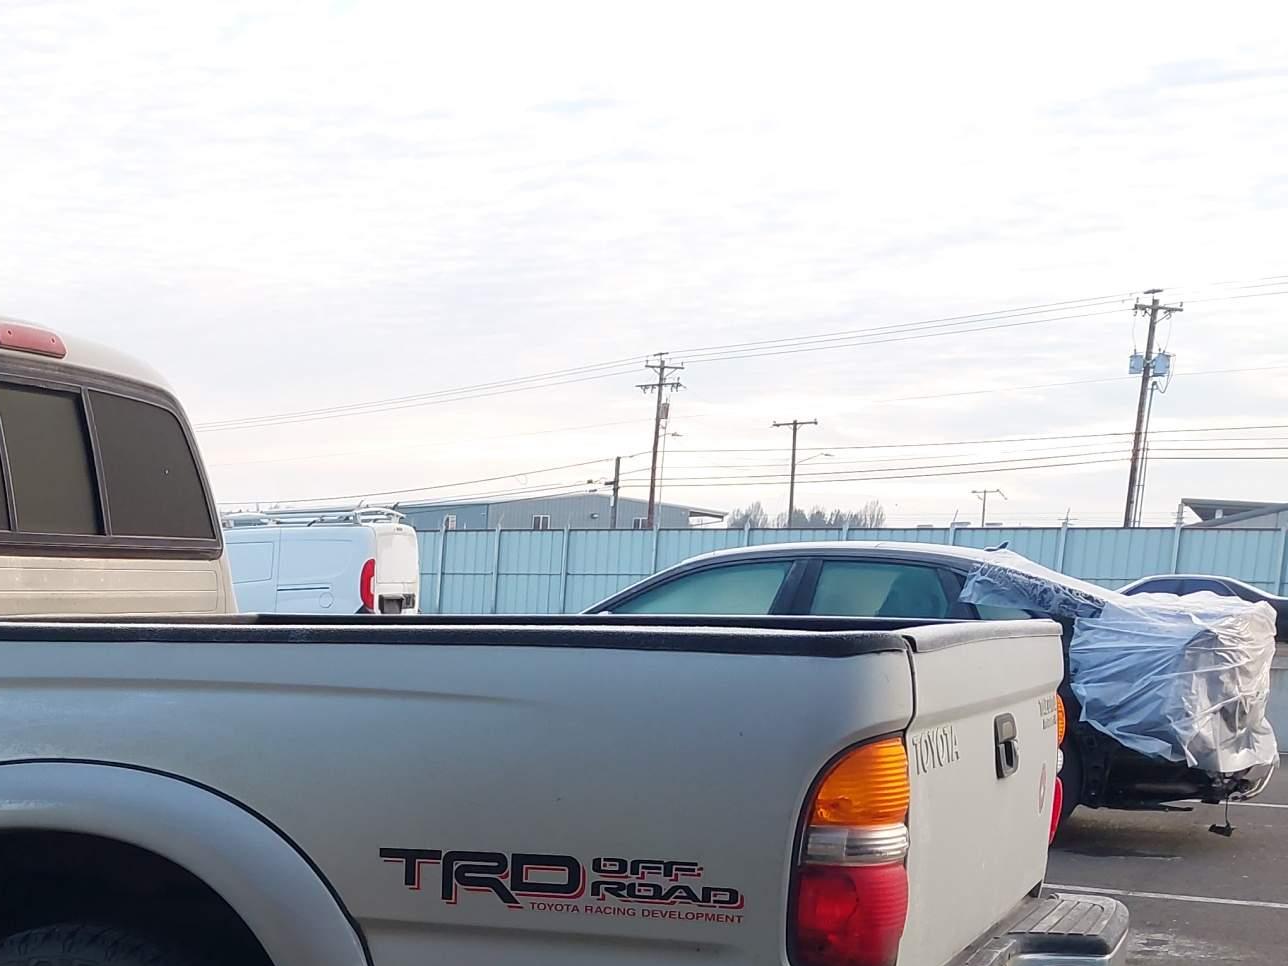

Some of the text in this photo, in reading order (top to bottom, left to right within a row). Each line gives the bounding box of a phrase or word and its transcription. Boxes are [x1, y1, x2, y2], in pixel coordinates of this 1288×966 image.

[911, 725, 960, 775] TOYOTA
[379, 847, 587, 909] TRD
[591, 857, 704, 882] OFF
[590, 880, 745, 910] ROAD
[530, 901, 744, 924] TOYOTA RACING DEVELOPMENT
